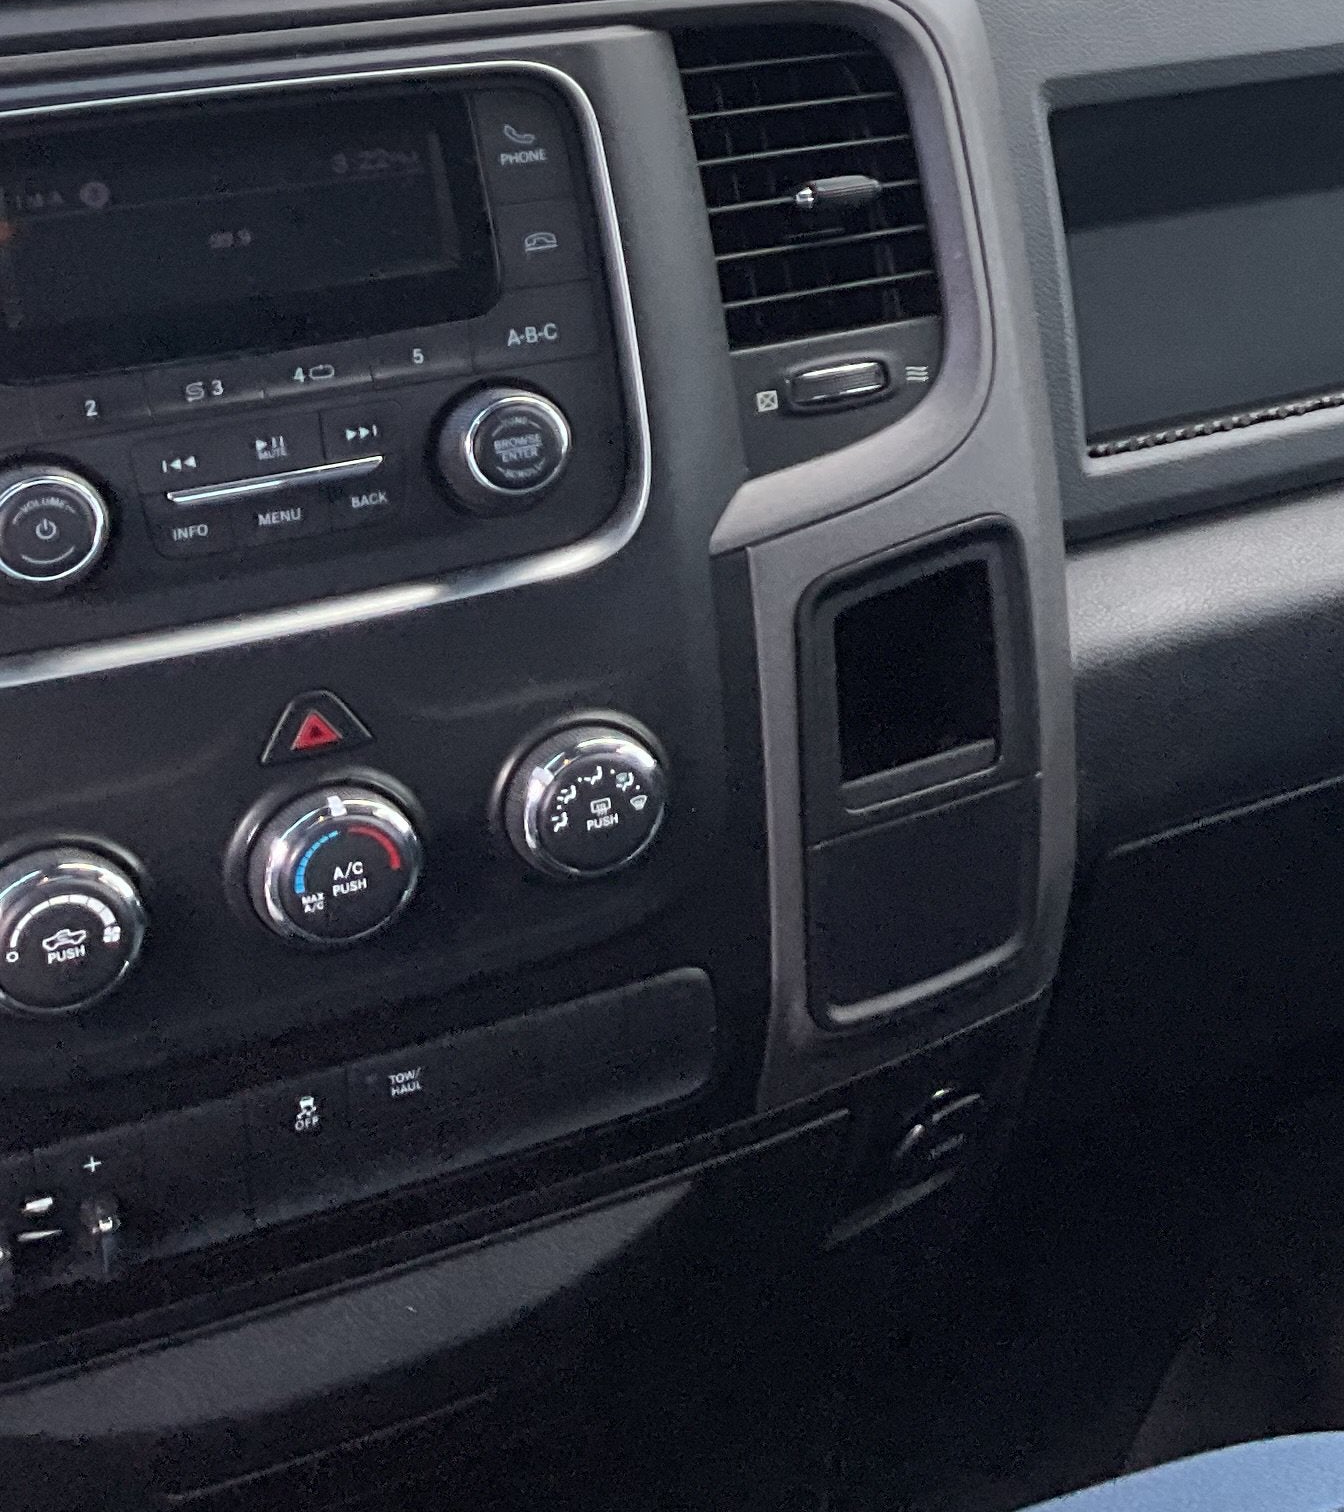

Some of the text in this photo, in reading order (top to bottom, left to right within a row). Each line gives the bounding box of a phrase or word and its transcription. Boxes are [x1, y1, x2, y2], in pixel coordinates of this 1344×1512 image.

[500, 148, 548, 166] PHONE
[411, 348, 424, 365] 5
[293, 367, 306, 383] 4
[210, 379, 224, 396] 3
[84, 399, 99, 417] 2
[257, 447, 288, 460] MUTE
[501, 447, 539, 464] ENTER
[351, 489, 388, 509] BACK
[257, 507, 302, 526] MENU
[172, 522, 209, 541] INFO
[586, 812, 619, 831] PUSH
[333, 861, 364, 881] A/C
[332, 877, 368, 897] PUSH
[301, 892, 325, 905] MAX
[304, 900, 324, 914] A/C
[47, 944, 86, 965] PUSH
[387, 1066, 421, 1085] TOW/
[391, 1080, 422, 1098] HAUL
[294, 1115, 319, 1131] OFF
